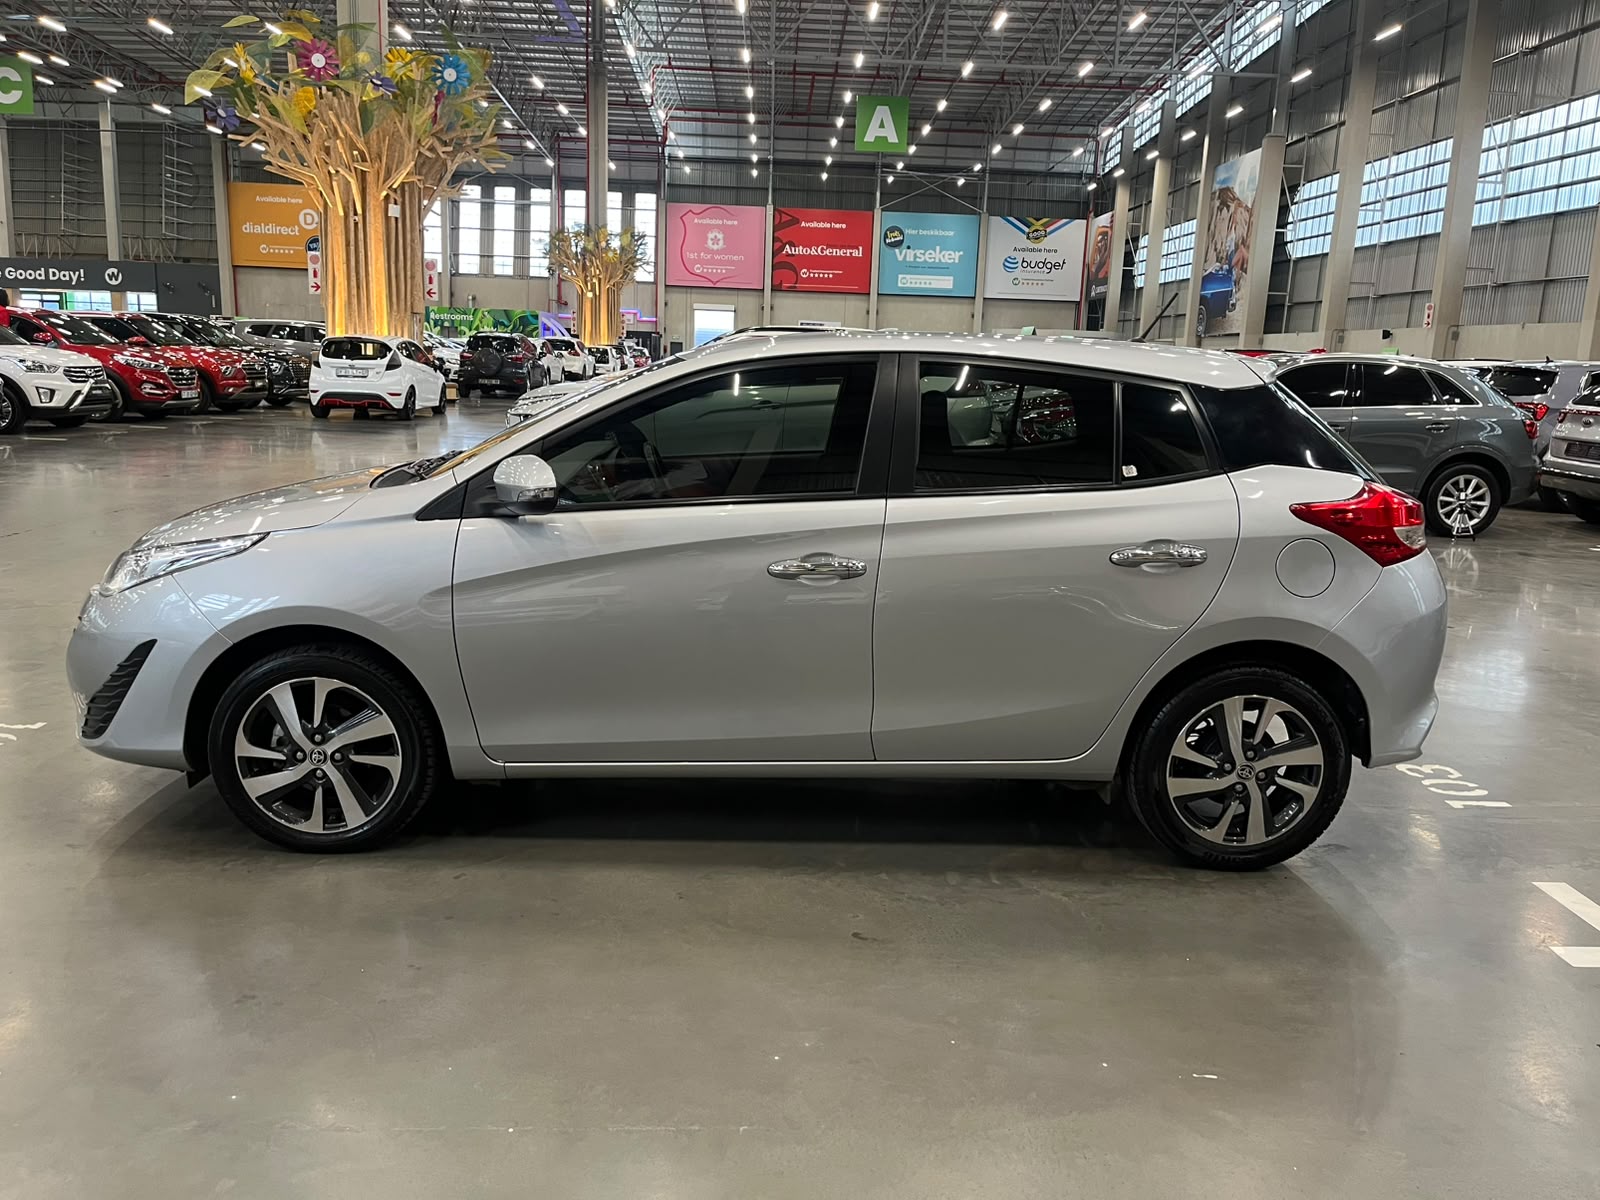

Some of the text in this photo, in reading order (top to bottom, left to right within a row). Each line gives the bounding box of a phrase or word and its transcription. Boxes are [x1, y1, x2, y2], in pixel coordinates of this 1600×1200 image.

[0, 67, 23, 104] C
[863, 105, 899, 143] A
[255, 195, 287, 203] Available
[693, 217, 723, 225] Available
[242, 222, 300, 235] dialdirect
[713, 253, 745, 261] women
[782, 244, 863, 257] Auto&General
[895, 245, 964, 263] virseker
[1020, 257, 1067, 274] budget
[4, 267, 46, 280] Good
[49, 268, 85, 285] Day!
[429, 312, 474, 321] Restrooms
